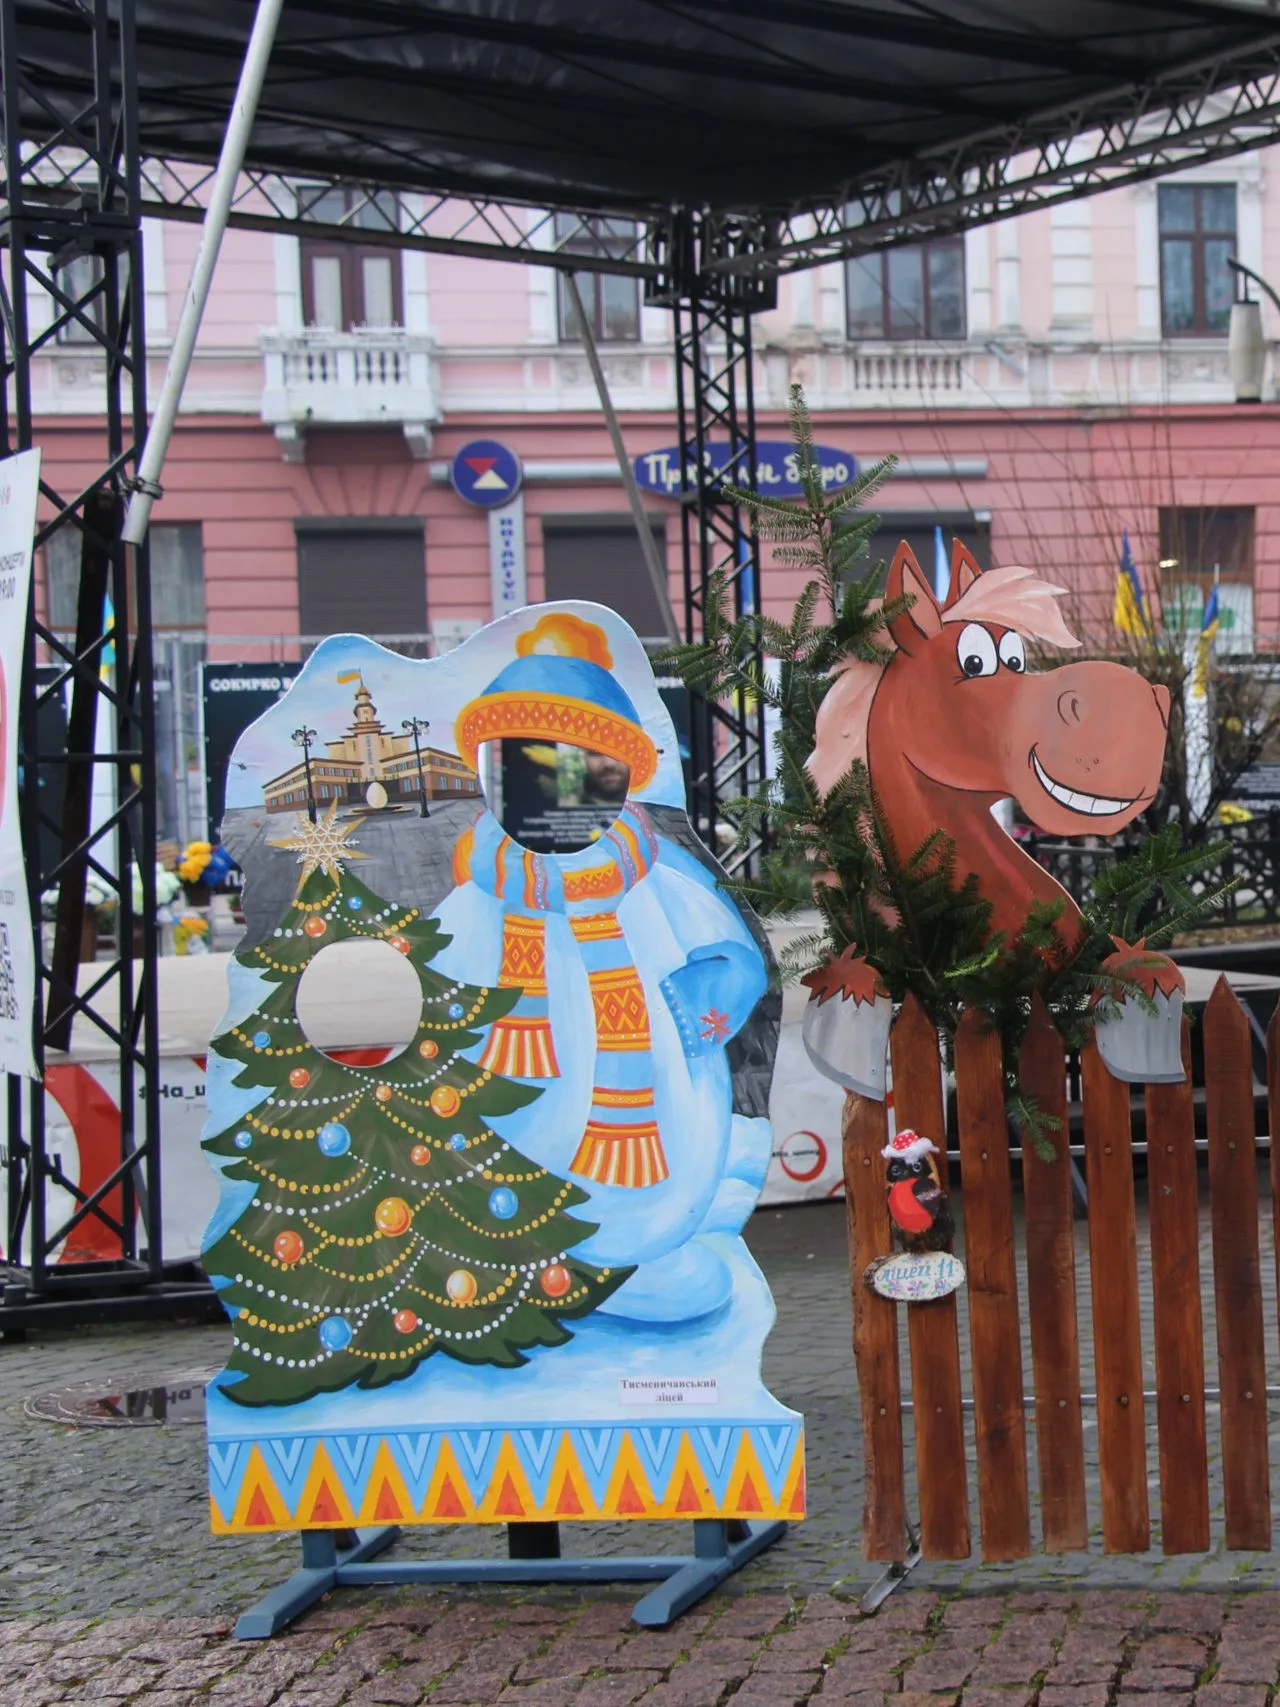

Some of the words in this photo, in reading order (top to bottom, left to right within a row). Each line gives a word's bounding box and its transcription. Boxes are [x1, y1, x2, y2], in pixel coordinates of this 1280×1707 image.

[210, 678, 281, 692] СОКИРКО
[620, 1379, 717, 1390] Тисменичанський
[655, 1391, 684, 1402] ліцей
